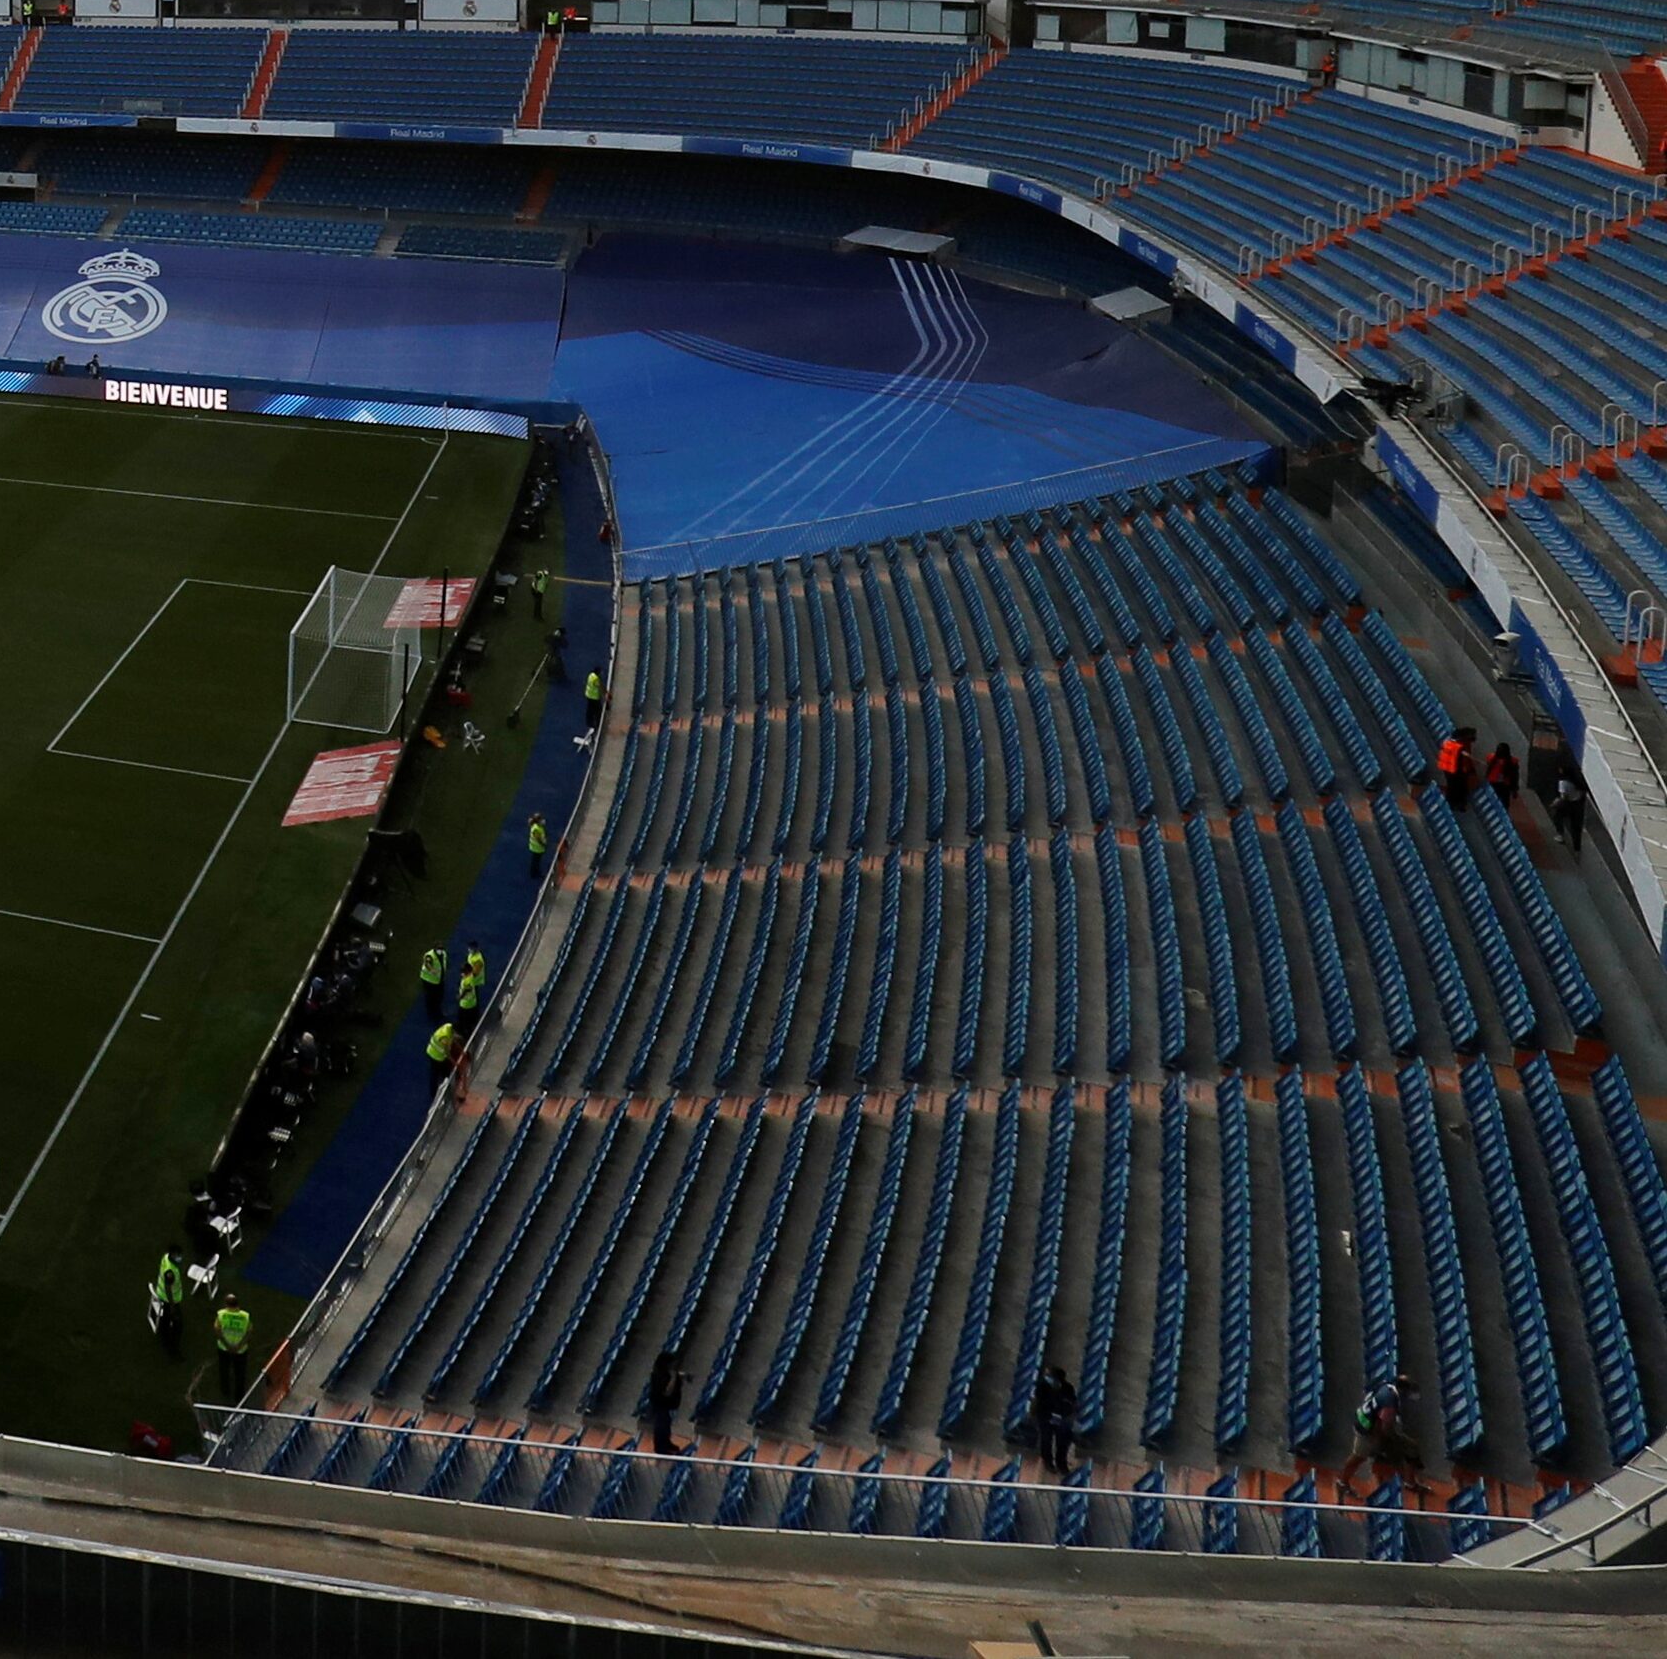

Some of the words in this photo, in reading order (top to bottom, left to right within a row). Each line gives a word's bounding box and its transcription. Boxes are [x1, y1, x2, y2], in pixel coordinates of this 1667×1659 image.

[39, 116, 57, 125] Real
[59, 117, 87, 126] Madrid
[391, 128, 409, 138] Real
[411, 129, 445, 139] Madrid
[742, 143, 763, 153] Real
[765, 146, 798, 157] Madrid
[105, 380, 228, 410] BIENVENUE
